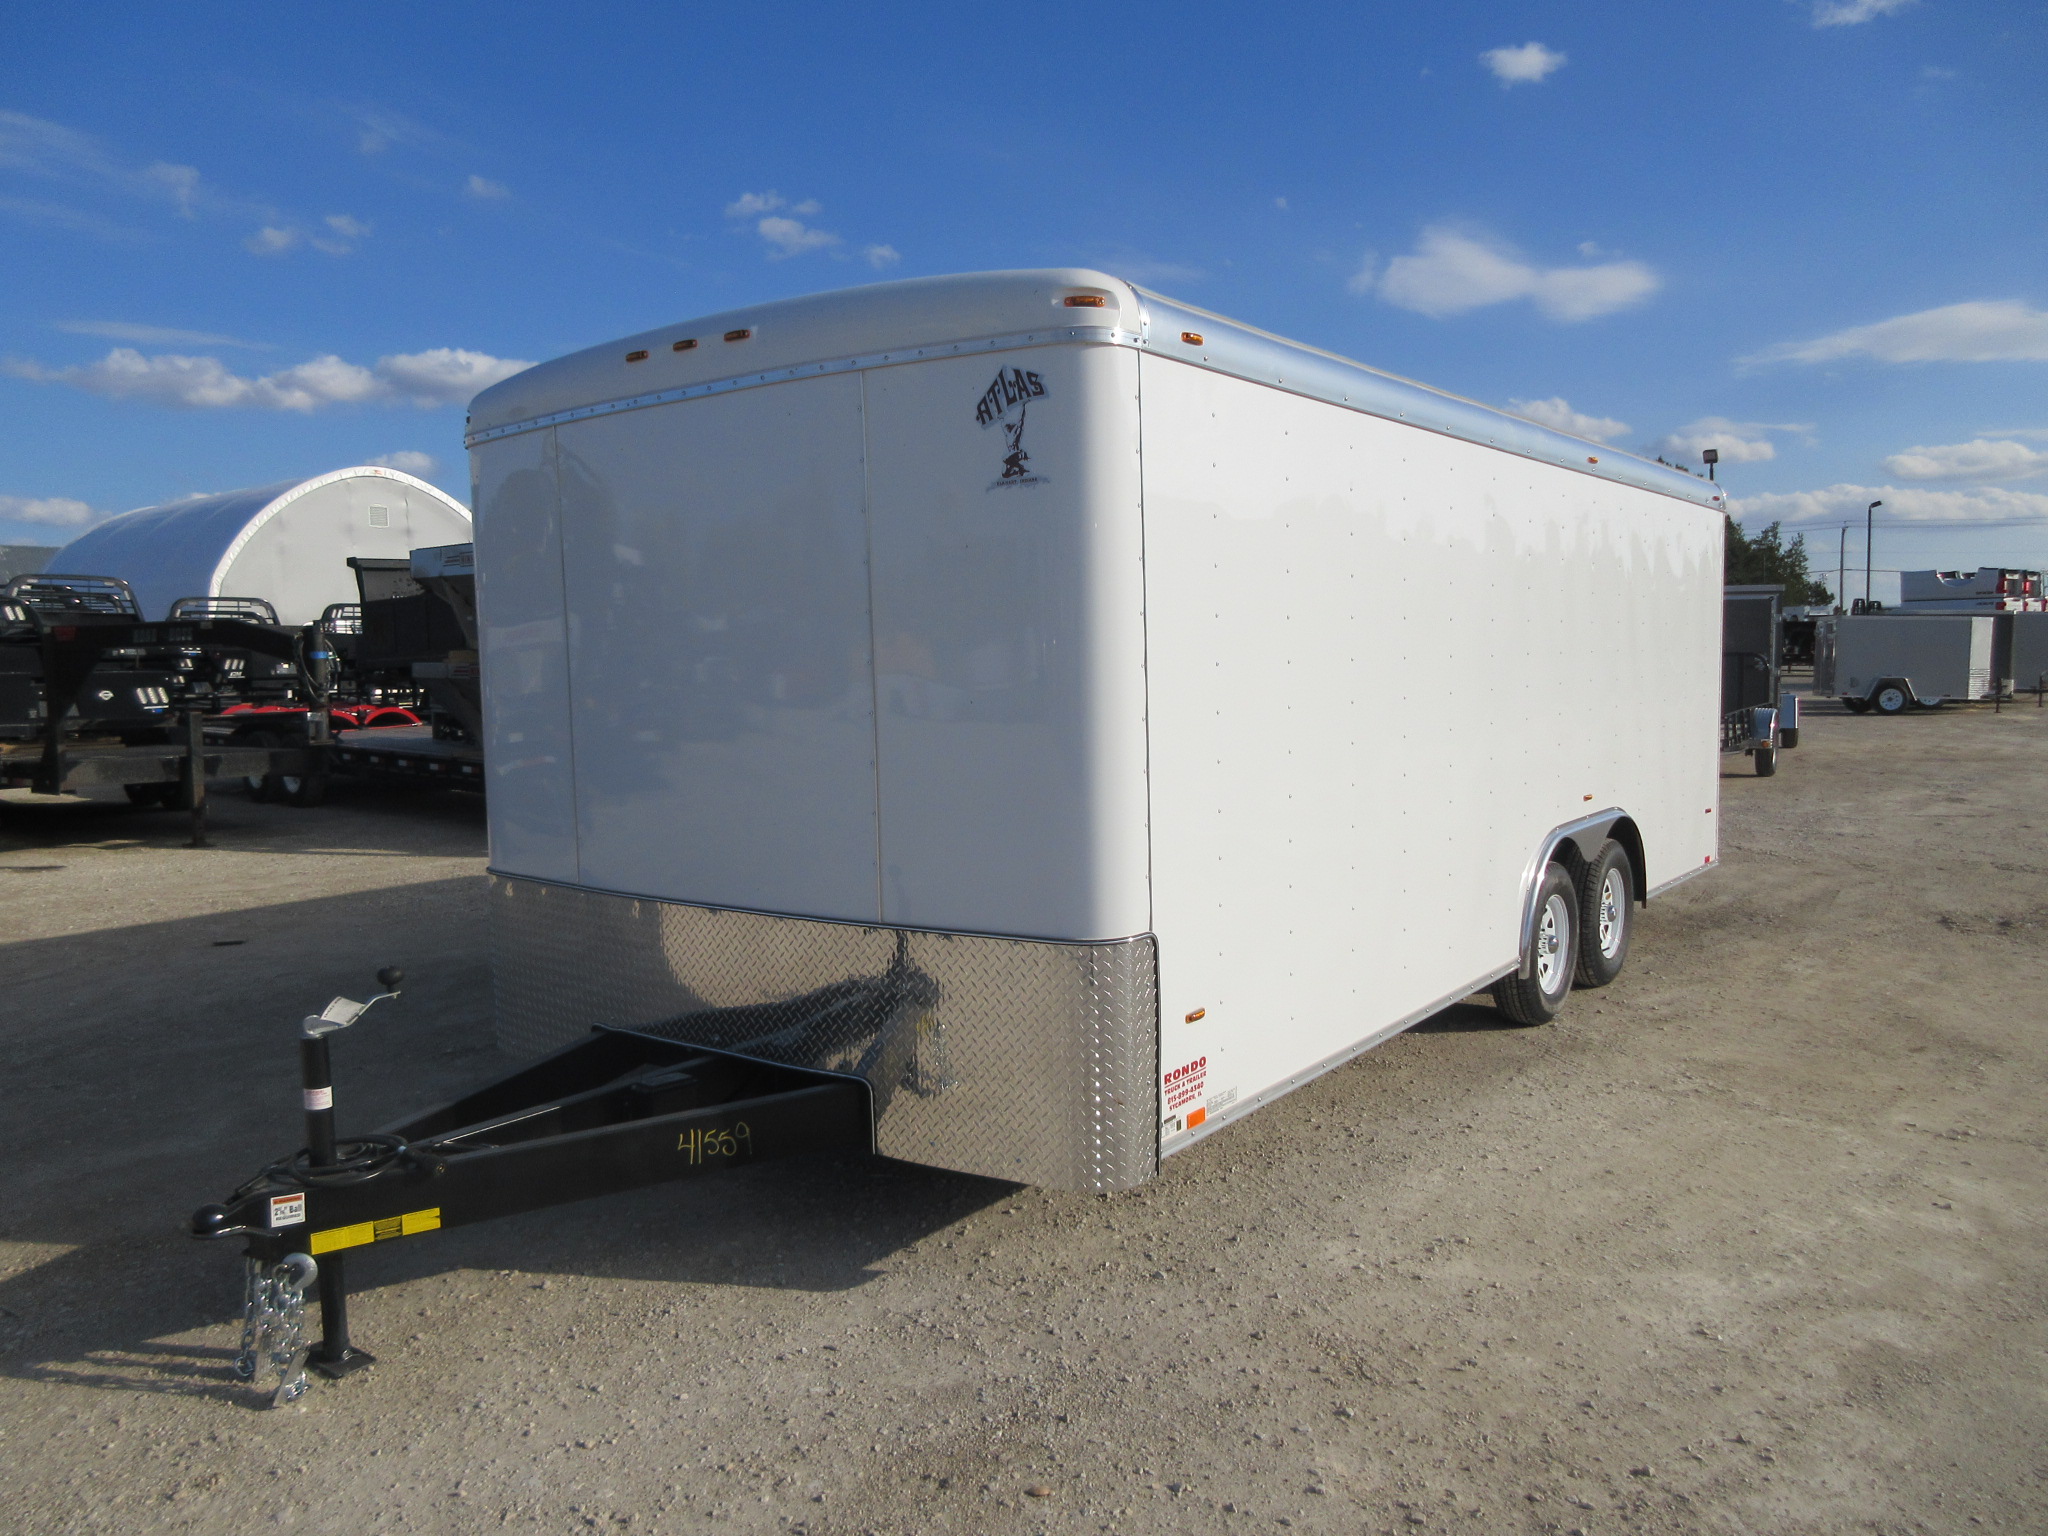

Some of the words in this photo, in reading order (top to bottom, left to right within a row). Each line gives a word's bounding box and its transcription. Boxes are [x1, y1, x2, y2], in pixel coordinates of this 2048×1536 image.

[976, 367, 1045, 425] ATLAS
[1164, 1056, 1207, 1085] RONDO
[1164, 1083, 1181, 1096] TRUCK
[1186, 1070, 1207, 1085] TRAILER
[677, 1121, 752, 1165] 41559
[289, 1204, 302, 1213] Ball
